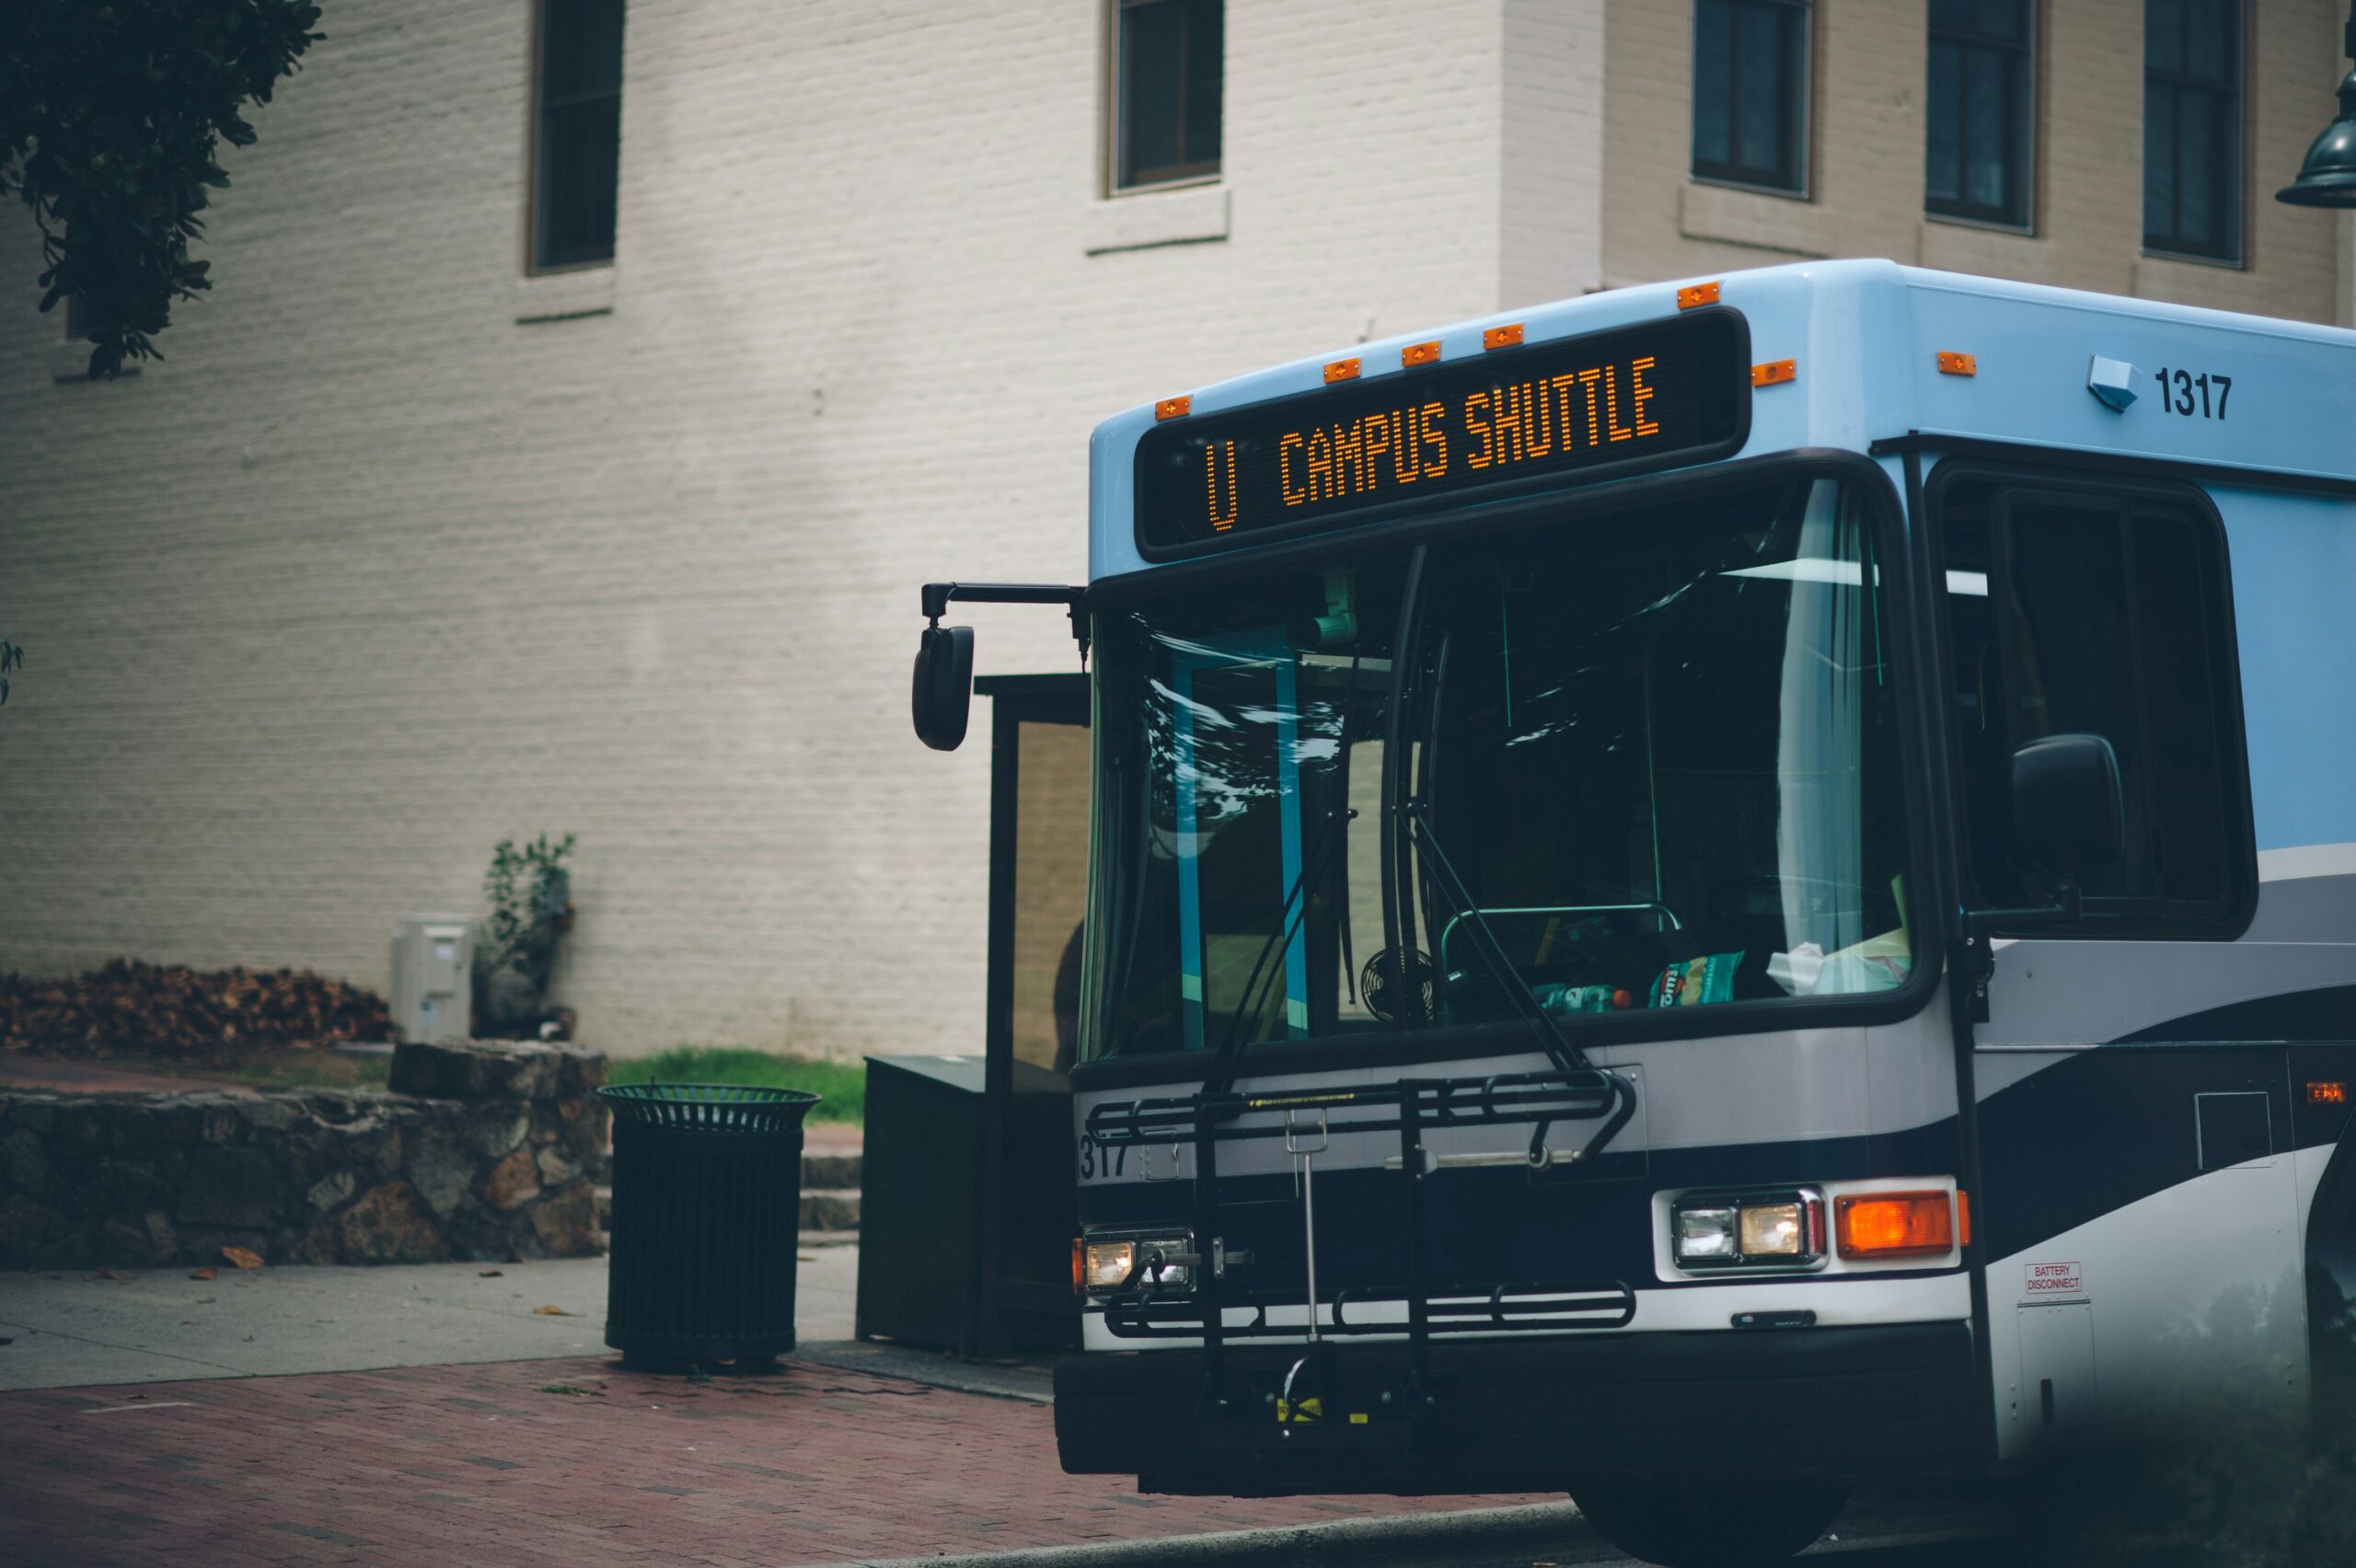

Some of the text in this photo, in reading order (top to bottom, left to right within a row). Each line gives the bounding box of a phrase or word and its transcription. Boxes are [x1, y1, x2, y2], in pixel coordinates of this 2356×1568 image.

[2154, 367, 2232, 421] 1317
[1207, 355, 1660, 531] U CAMPUS SHUTTLE
[2027, 1278, 2079, 1290] DISCONNECT
[2035, 1266, 2070, 1276] BATTERY
